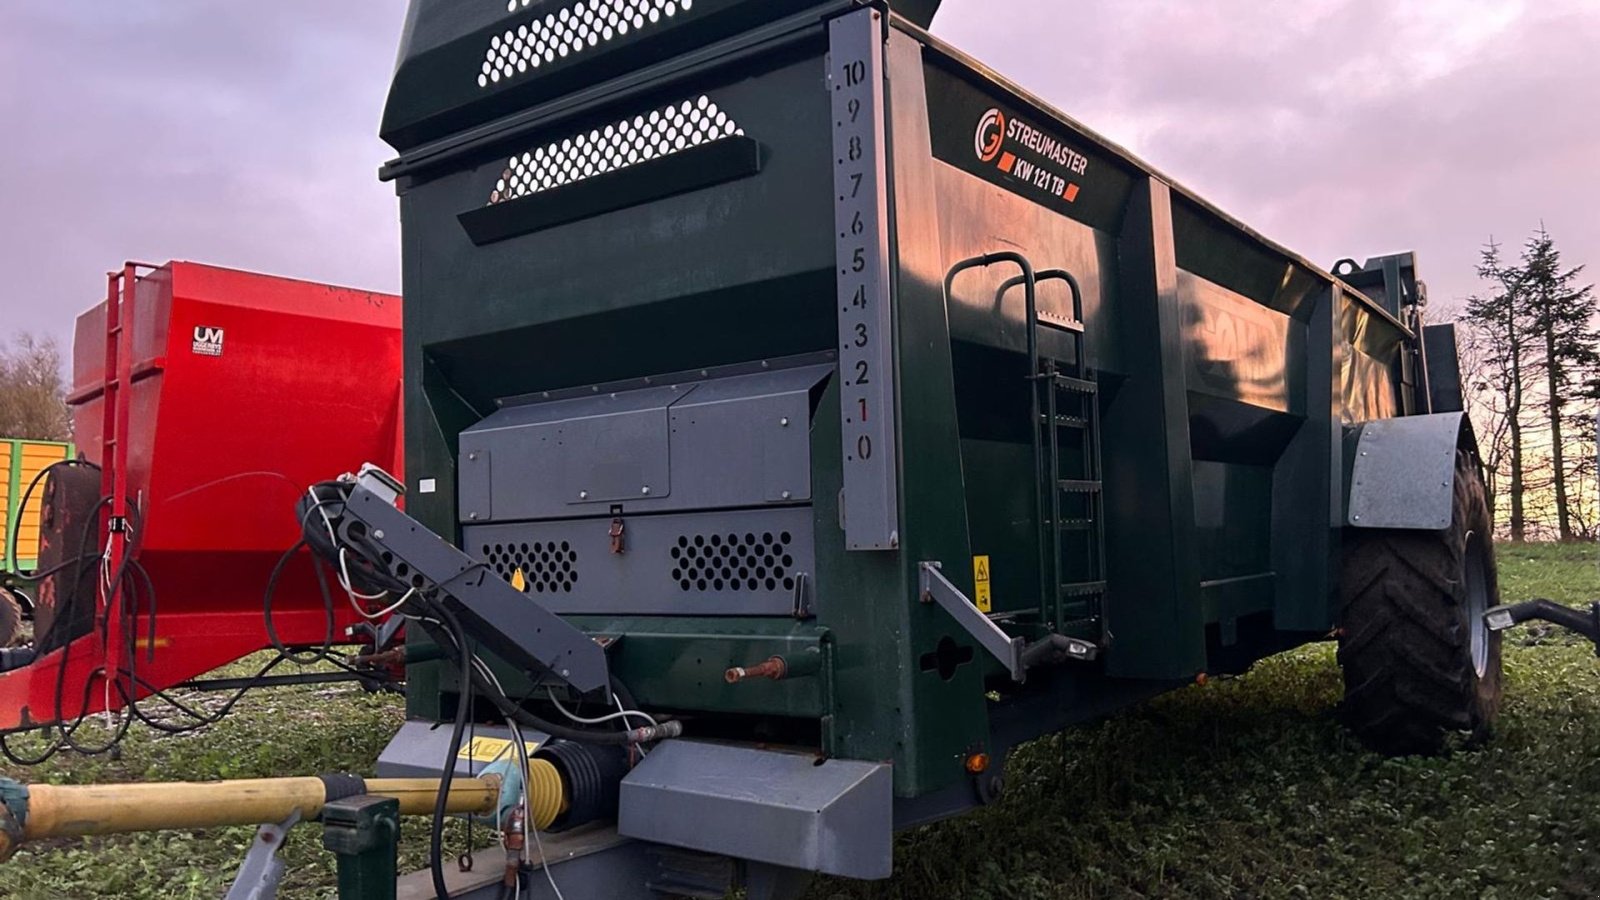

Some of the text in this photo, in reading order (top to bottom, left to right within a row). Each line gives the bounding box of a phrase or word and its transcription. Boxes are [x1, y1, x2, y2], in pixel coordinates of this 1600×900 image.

[843, 60, 866, 87] 10
[848, 98, 861, 122] 9
[848, 135, 862, 161] 8
[1006, 118, 1088, 175] STREUMASTER
[850, 172, 863, 198] 7
[1013, 158, 1066, 196] KW 121 TB
[851, 211, 864, 235] 6
[852, 248, 865, 272] 5
[853, 284, 867, 309] 4
[194, 326, 223, 344] UM
[855, 323, 868, 347] 3
[856, 360, 869, 385] 2
[858, 397, 867, 421] 1
[858, 435, 871, 460] 0
